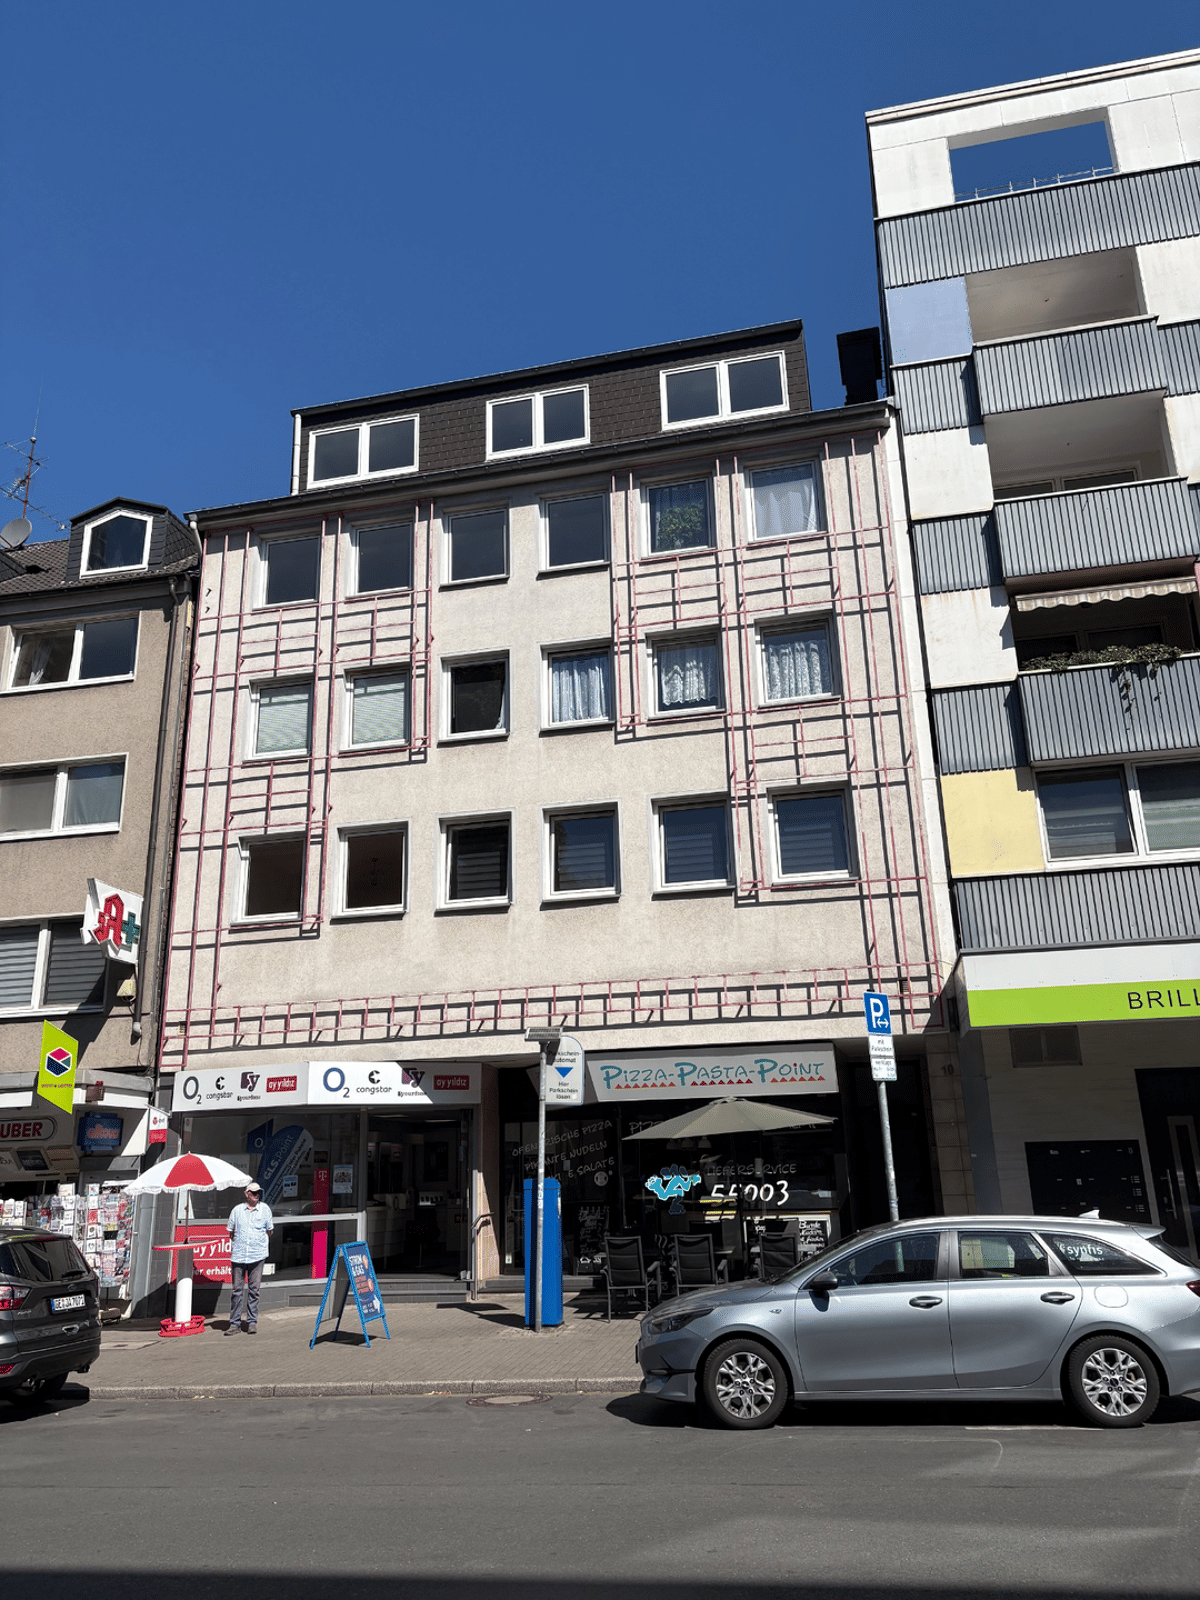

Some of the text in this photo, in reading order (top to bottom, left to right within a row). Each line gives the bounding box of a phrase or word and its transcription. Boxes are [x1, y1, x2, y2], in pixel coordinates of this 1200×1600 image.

[869, 998, 884, 1028] P
[206, 1091, 233, 1101] congstar
[356, 1086, 393, 1095] congstar
[511, 1119, 613, 1157] OFENRISCHE PIZZA
[569, 1140, 608, 1158] NUDELN
[576, 1156, 616, 1177] SALATE
[706, 1163, 798, 1177] LIEFERSRVICE
[209, 1239, 232, 1257] yıld
[206, 1265, 232, 1275] erhält
